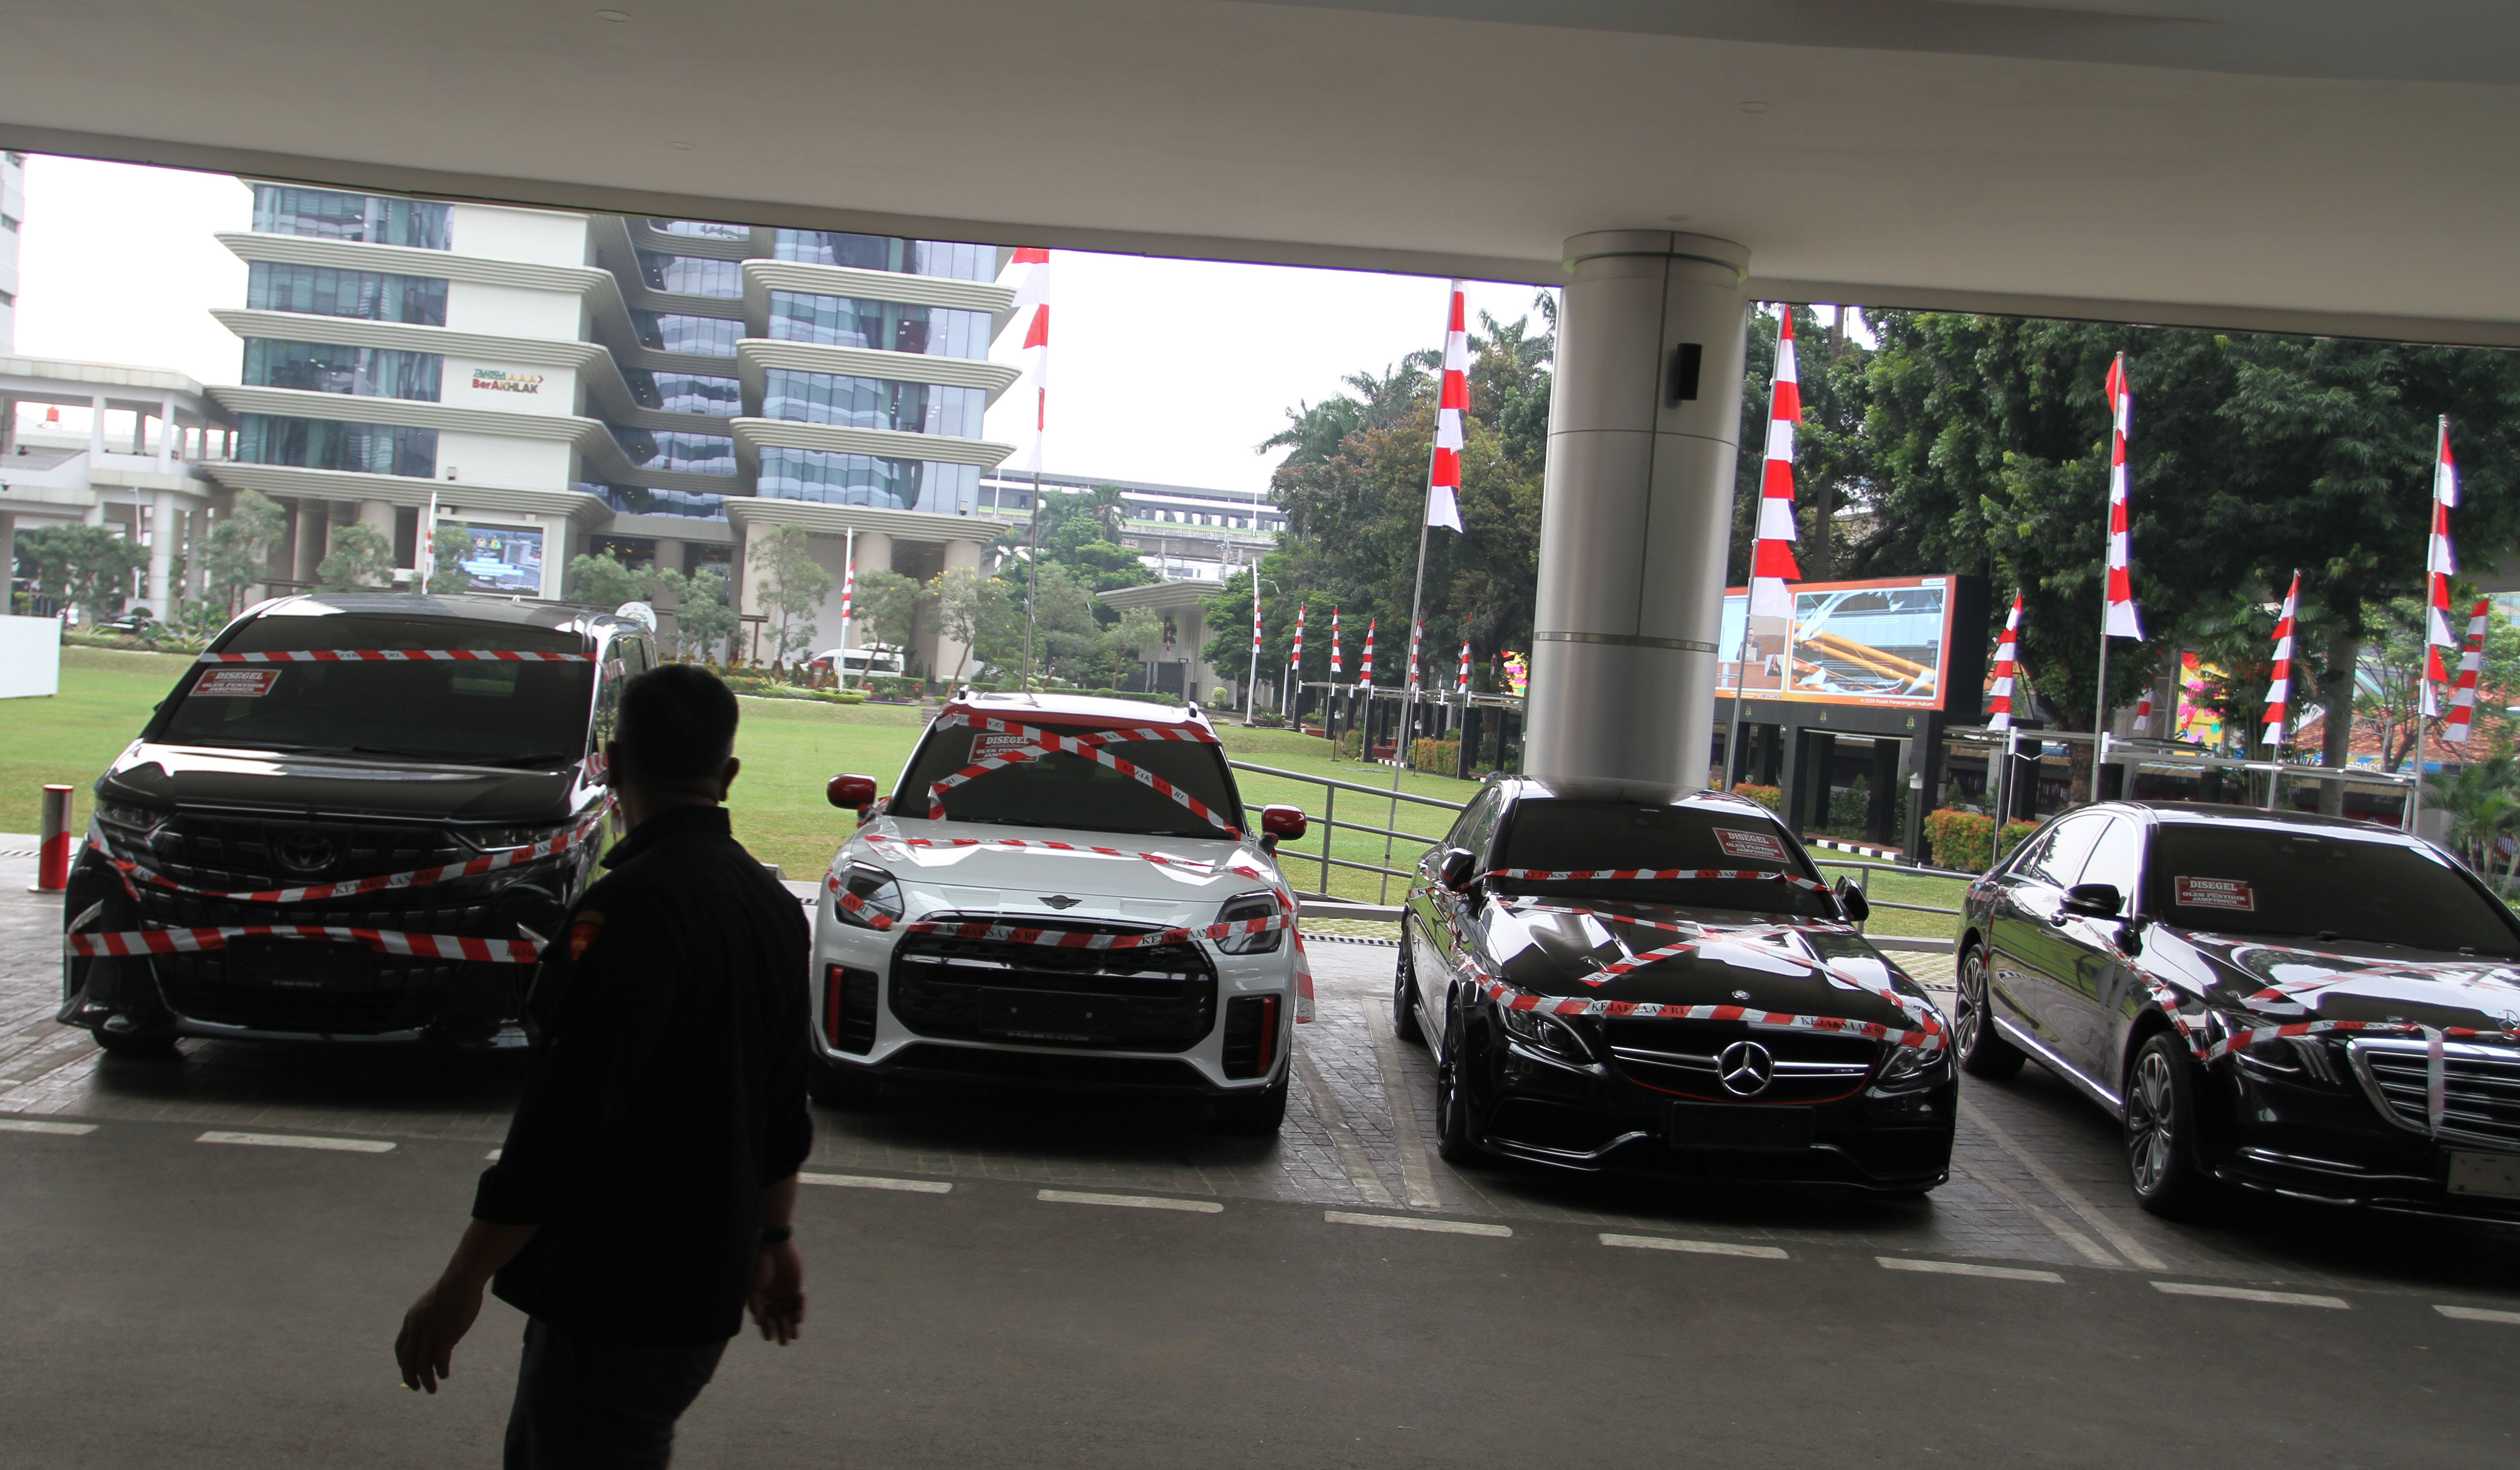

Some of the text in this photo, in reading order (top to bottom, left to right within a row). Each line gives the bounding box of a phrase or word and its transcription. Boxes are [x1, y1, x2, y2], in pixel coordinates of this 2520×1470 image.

[215, 672, 264, 680] DISEGEL
[986, 736, 1029, 744] DISEGEL
[1174, 791, 1185, 800] RI
[1727, 832, 1769, 844] DISEGEL
[1736, 848, 1775, 856] JAMPIDSUS
[1746, 845, 1780, 854] PENYIDIK
[2189, 880, 2237, 891] DISEGEL
[2206, 893, 2246, 901] PENYIDIK
[947, 924, 1037, 941] KEJAKSAAN RI
[1142, 927, 1222, 945] KEJAKSAAN RI
[1591, 1002, 1665, 1013] KEJAKSAAN
[1801, 1016, 1884, 1035] KEJAKSAAN RI
